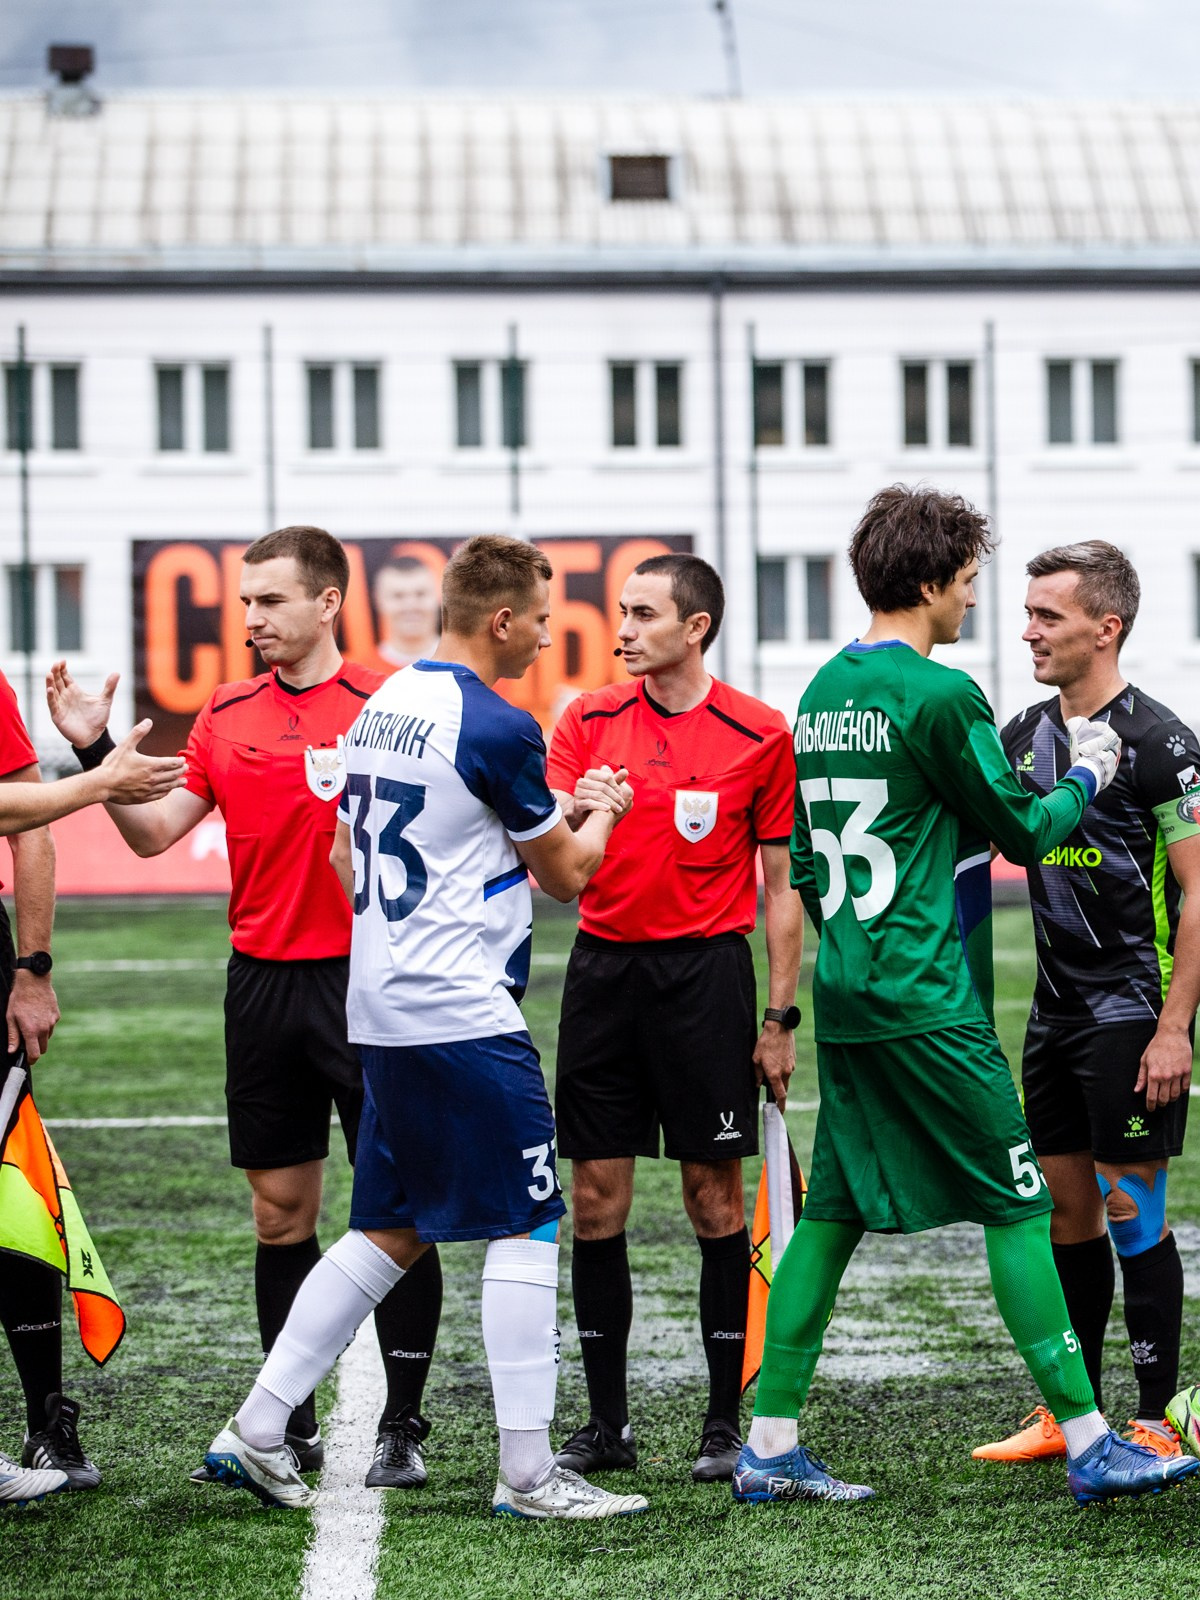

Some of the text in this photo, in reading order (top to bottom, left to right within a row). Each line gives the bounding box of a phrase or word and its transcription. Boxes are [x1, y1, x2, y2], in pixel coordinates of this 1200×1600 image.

[799, 777, 897, 922] 53
[1124, 1130, 1150, 1138] KELME
[522, 1142, 562, 1201] 3
[1009, 1141, 1048, 1198] 5
[12, 1320, 61, 1332] JÖGEL
[388, 1350, 431, 1359] JÖGEL
